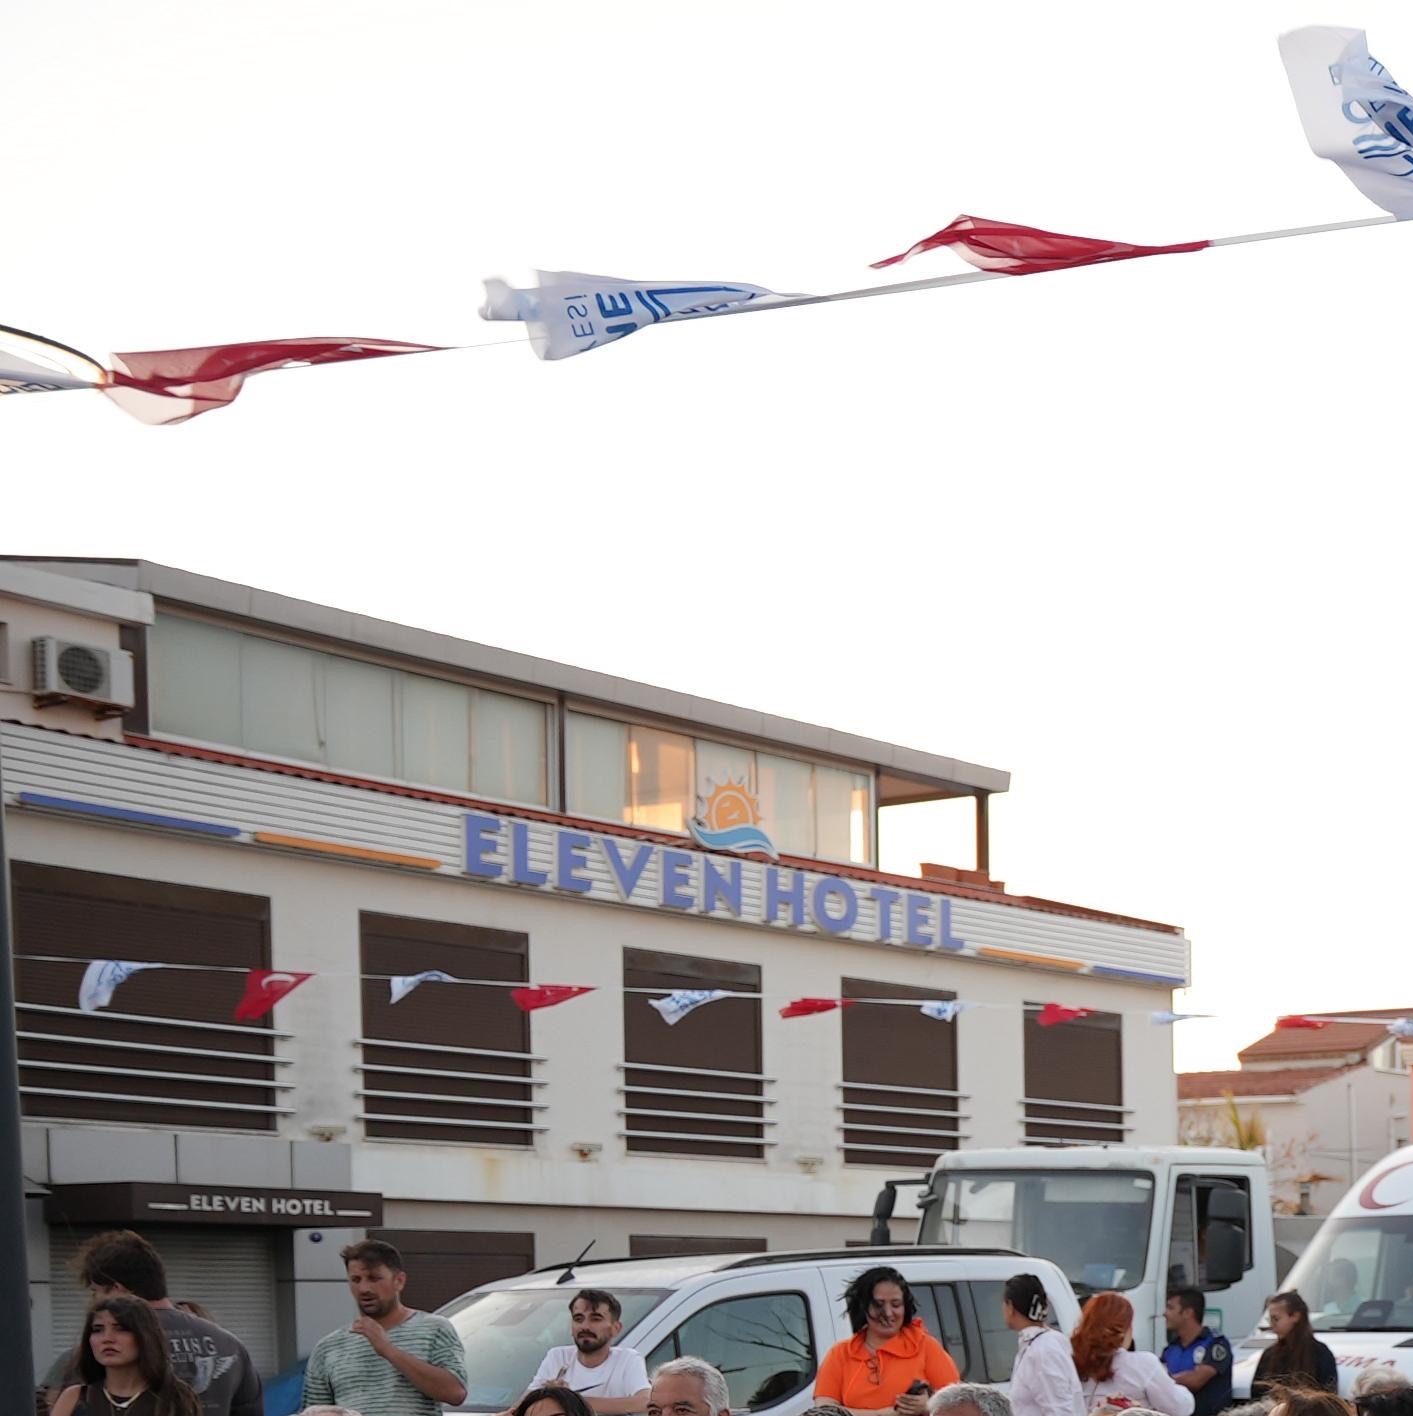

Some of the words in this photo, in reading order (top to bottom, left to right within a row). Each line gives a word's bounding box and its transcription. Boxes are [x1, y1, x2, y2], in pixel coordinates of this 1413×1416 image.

[462, 813, 742, 918] ELEVEN
[762, 864, 966, 951] HOTEL
[189, 1194, 266, 1213] ELEVEN
[271, 1197, 335, 1216] HOTEL
[170, 1336, 218, 1356] TING
